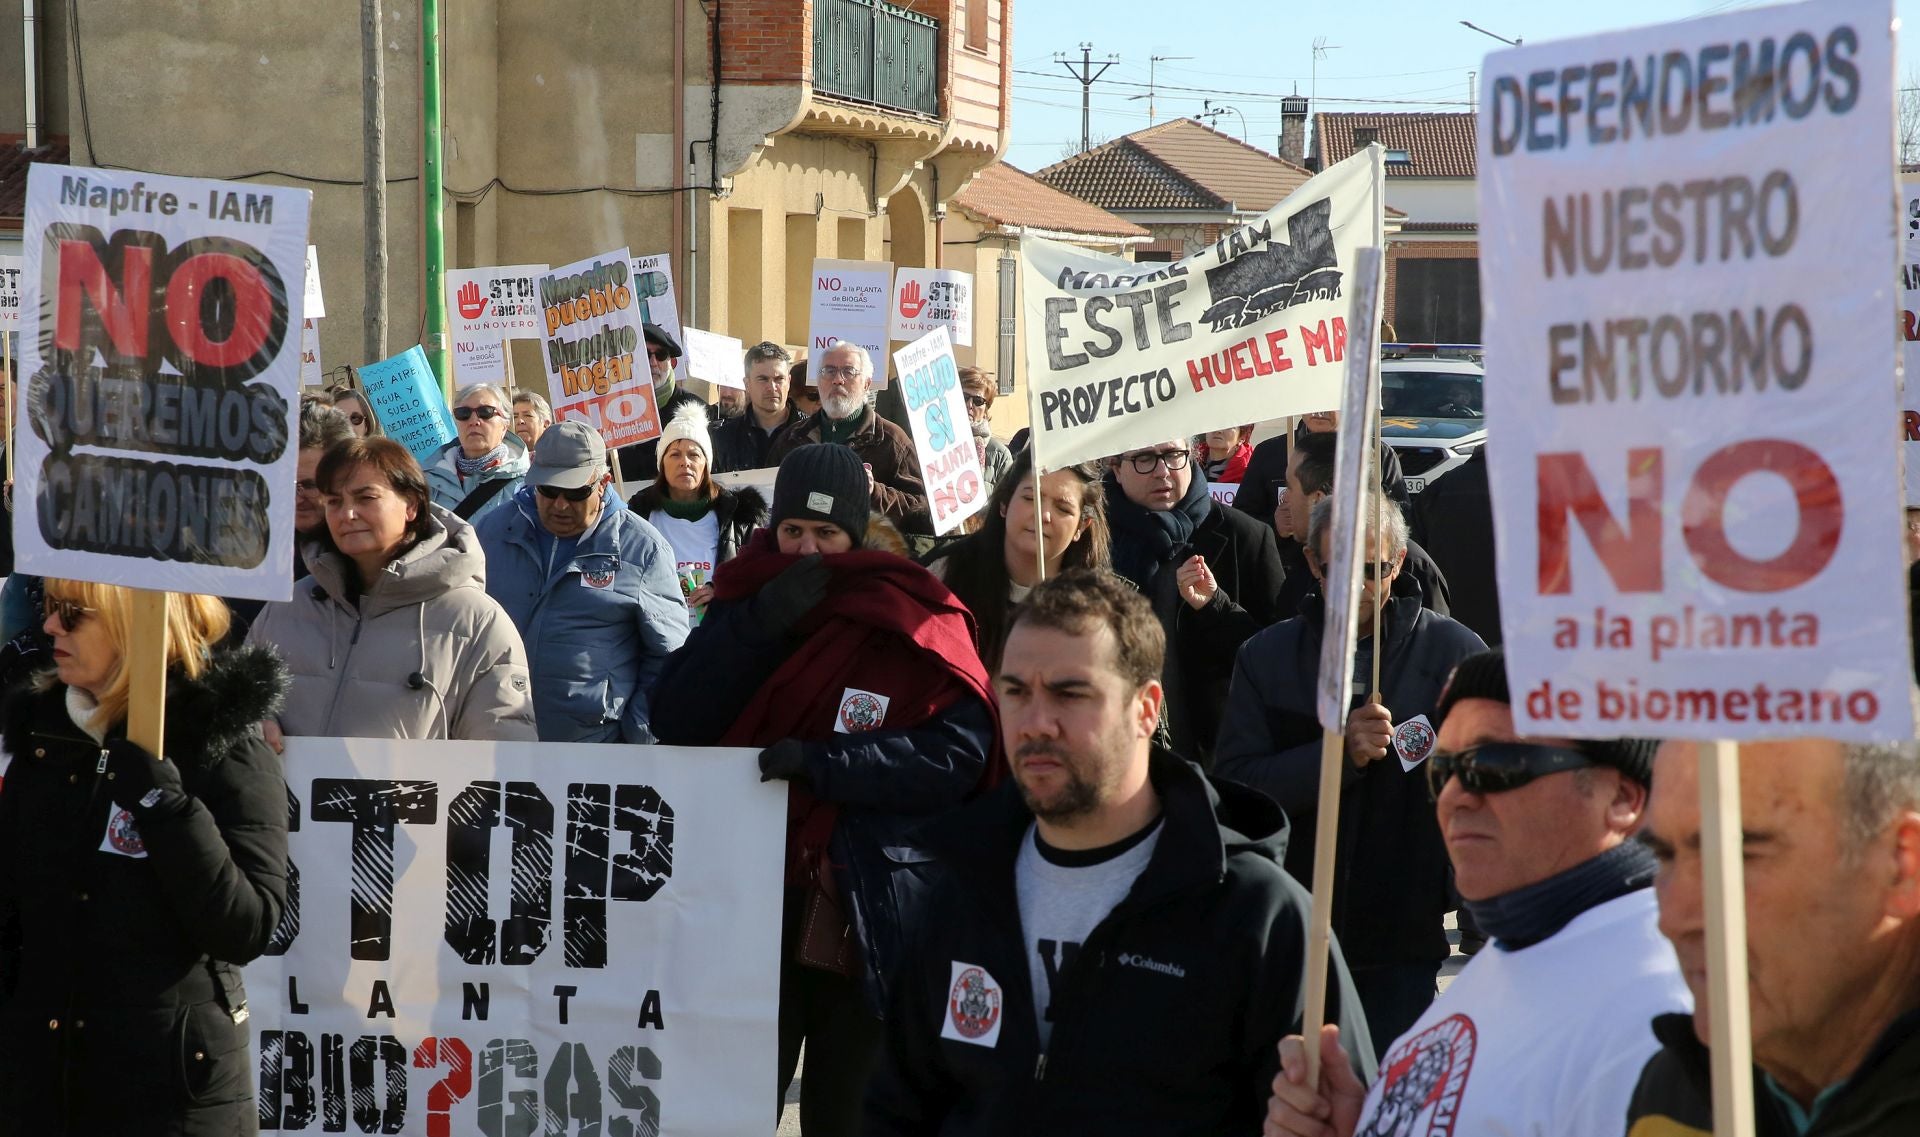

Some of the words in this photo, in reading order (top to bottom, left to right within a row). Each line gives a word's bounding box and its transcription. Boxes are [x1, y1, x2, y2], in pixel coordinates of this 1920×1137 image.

[1491, 25, 1860, 158] DEFENDEMOS
[60, 175, 179, 216] Mapfre
[209, 190, 274, 225] IAM
[1542, 171, 1800, 278] NUESTRO
[638, 257, 659, 270] IAM
[1216, 218, 1272, 264] IAM
[55, 238, 273, 368] NO
[539, 260, 628, 309] Nuestro
[818, 277, 841, 291] NO
[929, 282, 967, 303] STOP
[463, 320, 539, 331] MUÑOVERO
[544, 283, 631, 337] pueblo
[1045, 279, 1192, 371] ESTE
[457, 341, 475, 353] NO
[547, 323, 637, 374] Nuestro
[901, 347, 927, 369] Mapfre
[1549, 303, 1813, 404] ENTORNO
[377, 391, 402, 406] AGUA
[406, 386, 414, 394] Y
[560, 353, 633, 397] hogar
[904, 353, 956, 412] SALUD
[1040, 367, 1177, 431] PROYECTO
[1186, 328, 1293, 393] HUELE
[30, 370, 287, 457] QUEREMOS
[387, 399, 420, 417] SUELO
[926, 441, 974, 485] PLANTA
[44, 455, 268, 558] CAMIONES
[933, 469, 979, 521] NO
[1537, 438, 1845, 595] NO
[1555, 614, 1579, 649] a
[1595, 606, 1633, 650] la
[1650, 606, 1820, 661] planta
[1527, 681, 1590, 722] de
[1598, 678, 1880, 724] biometano
[263, 777, 675, 968] TOP
[1130, 954, 1185, 978] Columbia
[289, 975, 664, 1031] LANTA
